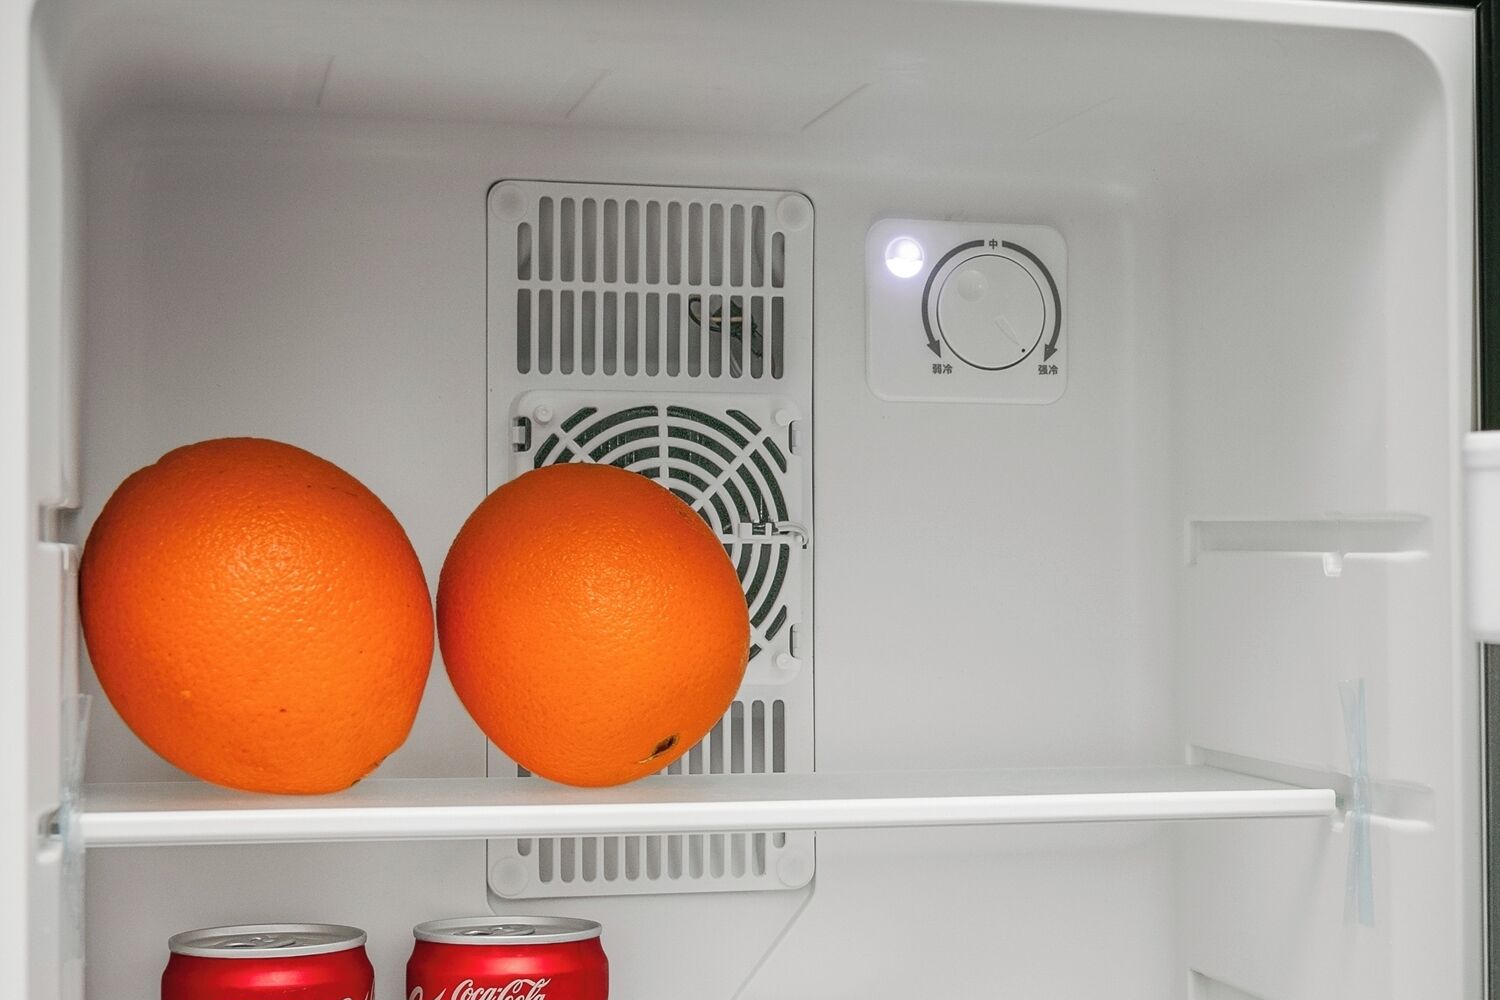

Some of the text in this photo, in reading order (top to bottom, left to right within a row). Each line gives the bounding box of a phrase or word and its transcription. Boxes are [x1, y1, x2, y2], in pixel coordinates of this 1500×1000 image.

[989, 238, 998, 250] 中
[932, 363, 953, 375] 弱冷
[1038, 364, 1058, 376] 强冷
